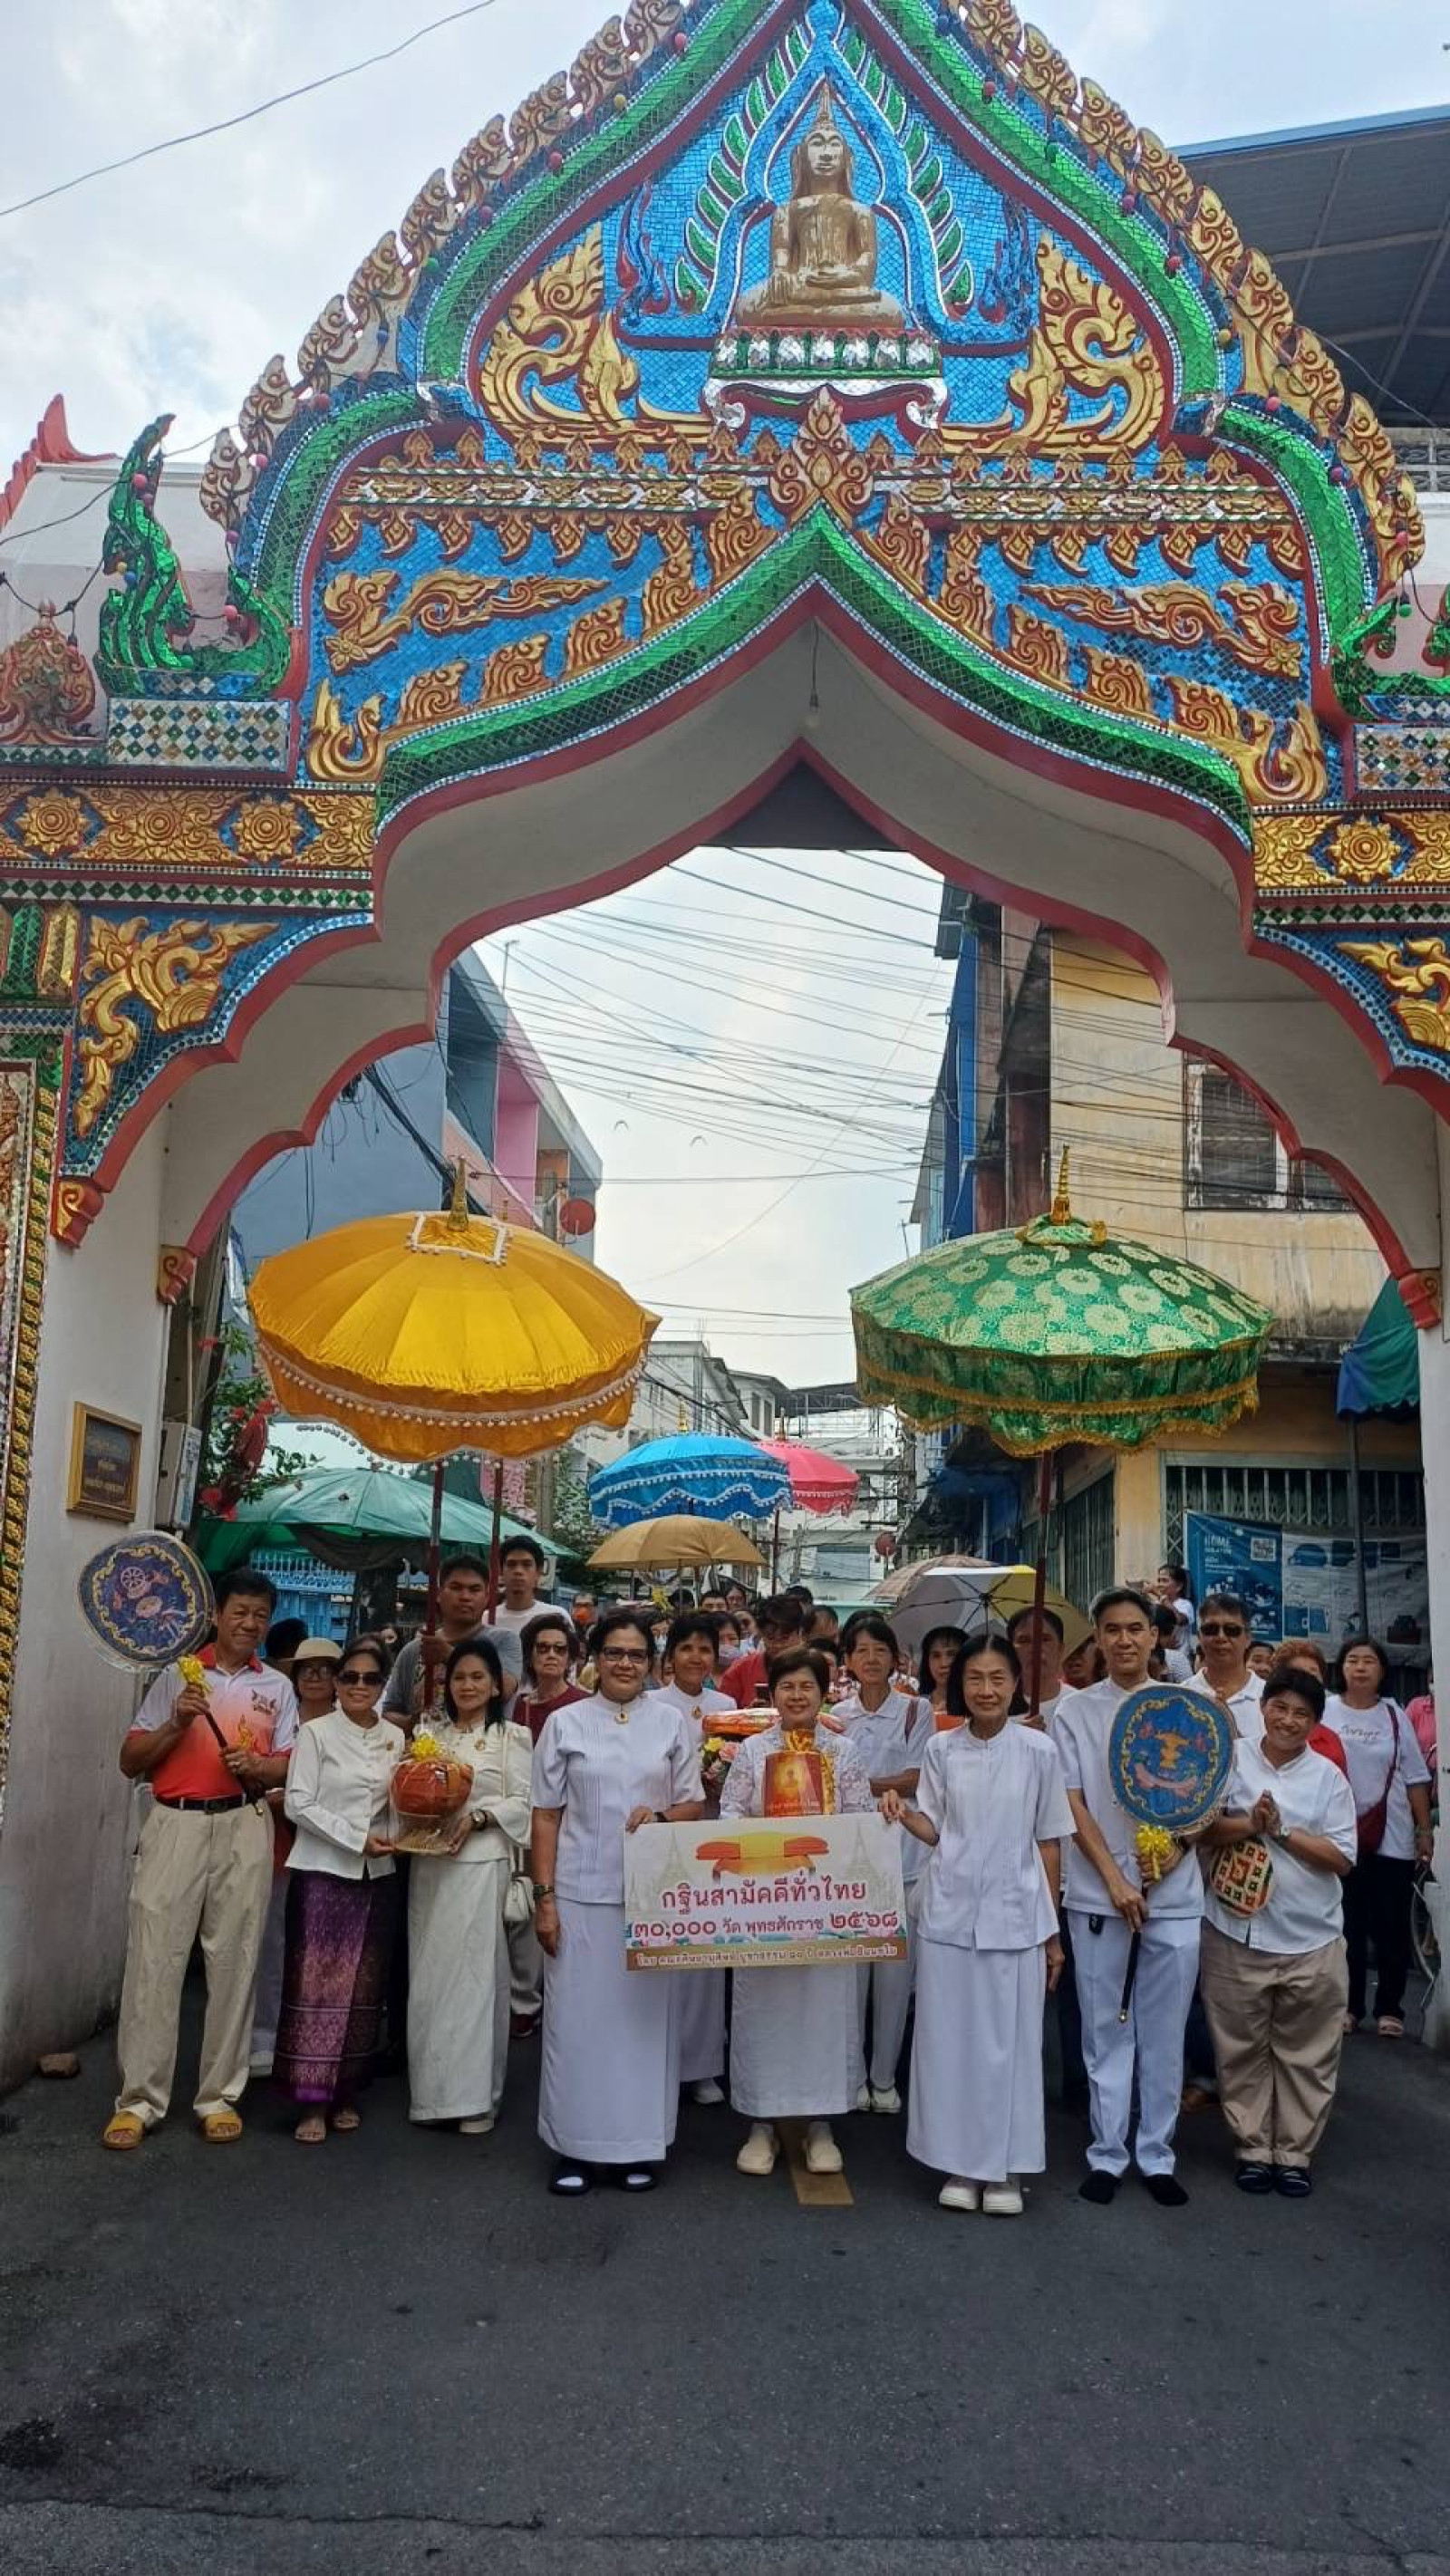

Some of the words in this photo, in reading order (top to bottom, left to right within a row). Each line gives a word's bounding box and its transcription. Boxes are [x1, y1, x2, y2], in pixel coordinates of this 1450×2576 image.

[662, 1871, 867, 1915] กฐินสามัคคีทั่วไทย
[633, 1920, 717, 1940] ๓๐,๐๐๐
[722, 1916, 741, 1934] วัด
[746, 1915, 824, 1938] พุทธศักราช
[829, 1910, 899, 1929] ๒๕๖๘
